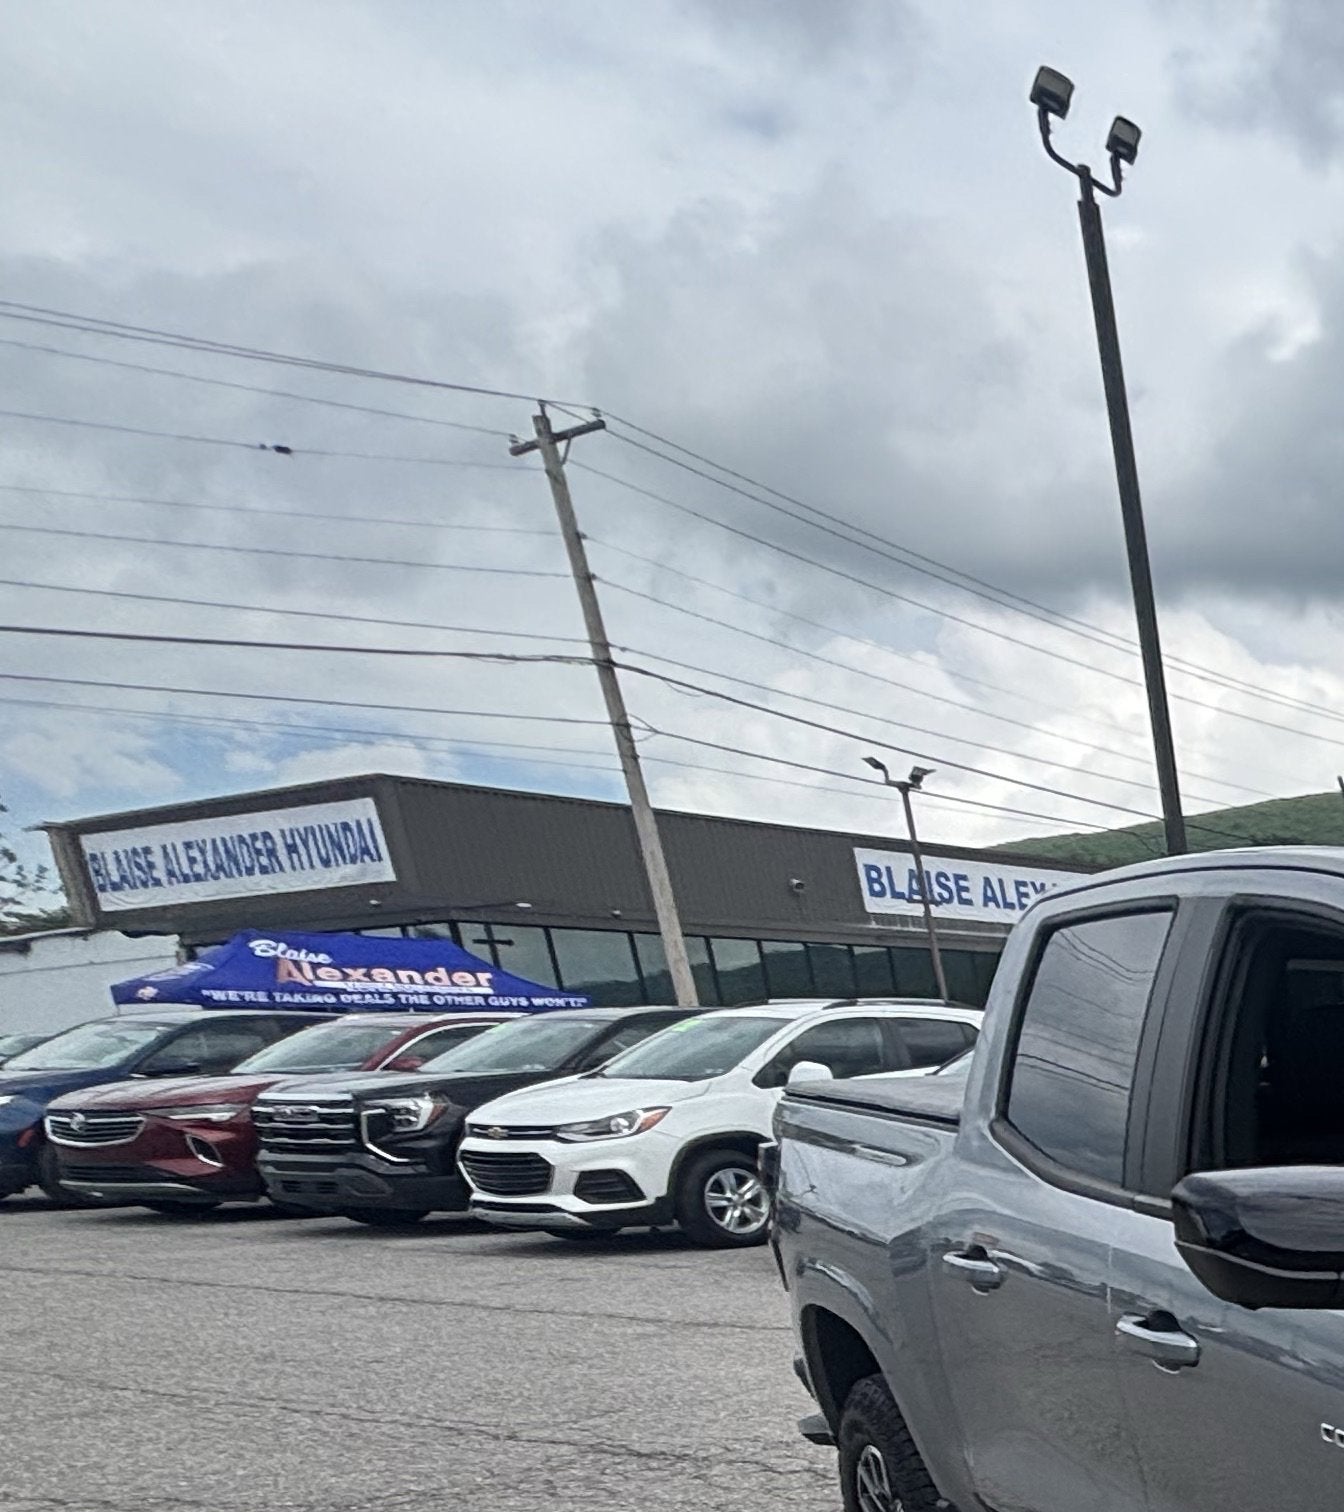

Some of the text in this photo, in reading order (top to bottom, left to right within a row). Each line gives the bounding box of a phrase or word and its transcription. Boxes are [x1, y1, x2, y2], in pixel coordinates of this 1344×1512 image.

[89, 818, 383, 892] BLAISE ALEXANDER HYUNDAI
[863, 864, 973, 906] BLAISE
[249, 939, 333, 965] Blaise
[276, 958, 494, 988] Alexander
[272, 992, 337, 1004] TAKING
[340, 994, 396, 1005] DEALS
[399, 994, 429, 1005] THE
[433, 995, 486, 1006] OTHER
[487, 996, 529, 1008] GUYS
